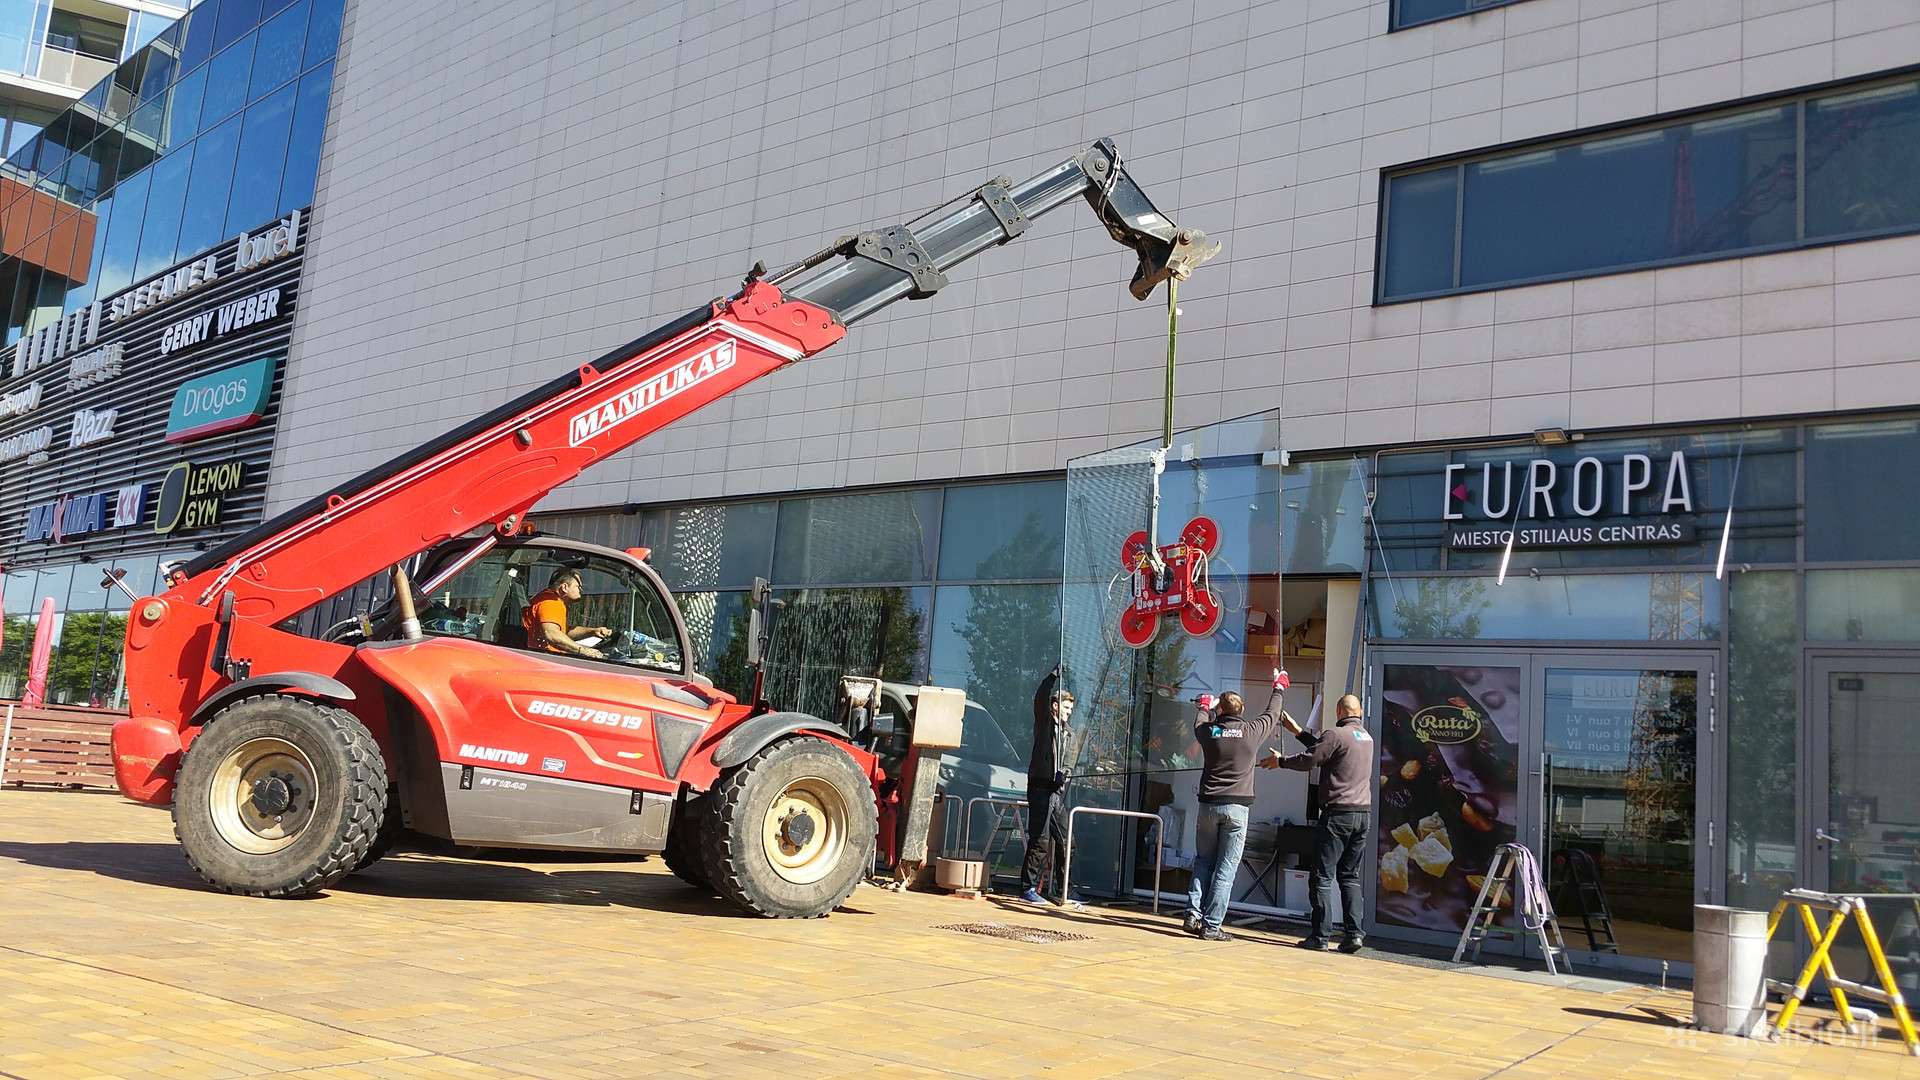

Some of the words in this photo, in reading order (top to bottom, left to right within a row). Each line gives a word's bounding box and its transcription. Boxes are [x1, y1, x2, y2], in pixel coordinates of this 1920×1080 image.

[110, 256, 218, 322] STEFANEL
[161, 311, 215, 355] GERRY
[217, 288, 280, 335] WEBER
[183, 378, 248, 417] Drogas
[574, 342, 734, 442] MANITUKAS
[189, 461, 242, 496] LEMON
[1444, 450, 1693, 520] EUROPA
[25, 492, 106, 544] MAXIMA
[185, 498, 219, 528] GYM
[1452, 530, 1514, 546] MIESTO
[1520, 527, 1592, 544] STILIAUS
[1598, 524, 1682, 542] CENTRAS
[458, 743, 529, 766] MANITOU
